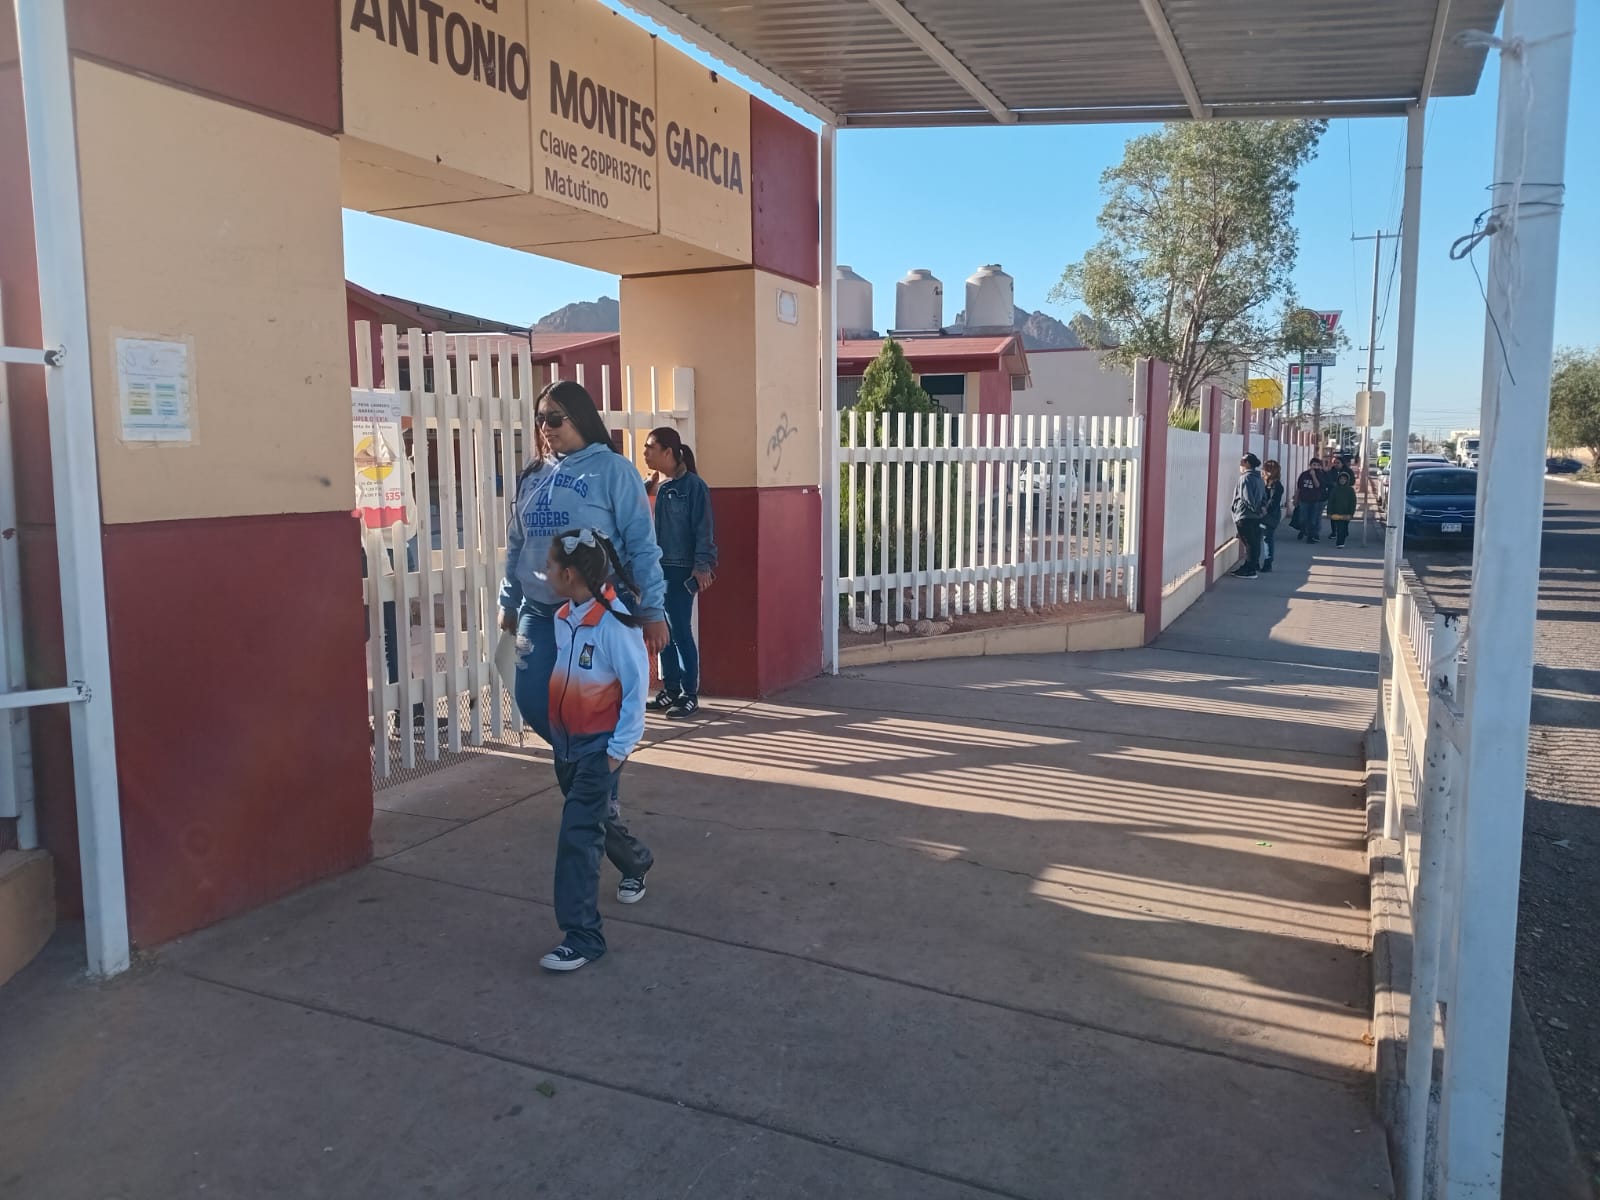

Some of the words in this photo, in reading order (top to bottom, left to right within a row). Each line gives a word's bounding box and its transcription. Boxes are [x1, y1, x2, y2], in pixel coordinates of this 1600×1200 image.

[350, 0, 529, 101] ANTONIO
[550, 60, 656, 157] MONTES
[666, 121, 744, 195] GARCIA
[540, 129, 577, 165] Clave
[581, 145, 652, 191] 26DPR1371C
[545, 167, 609, 209] Matutino
[524, 511, 570, 527] ODGERS
